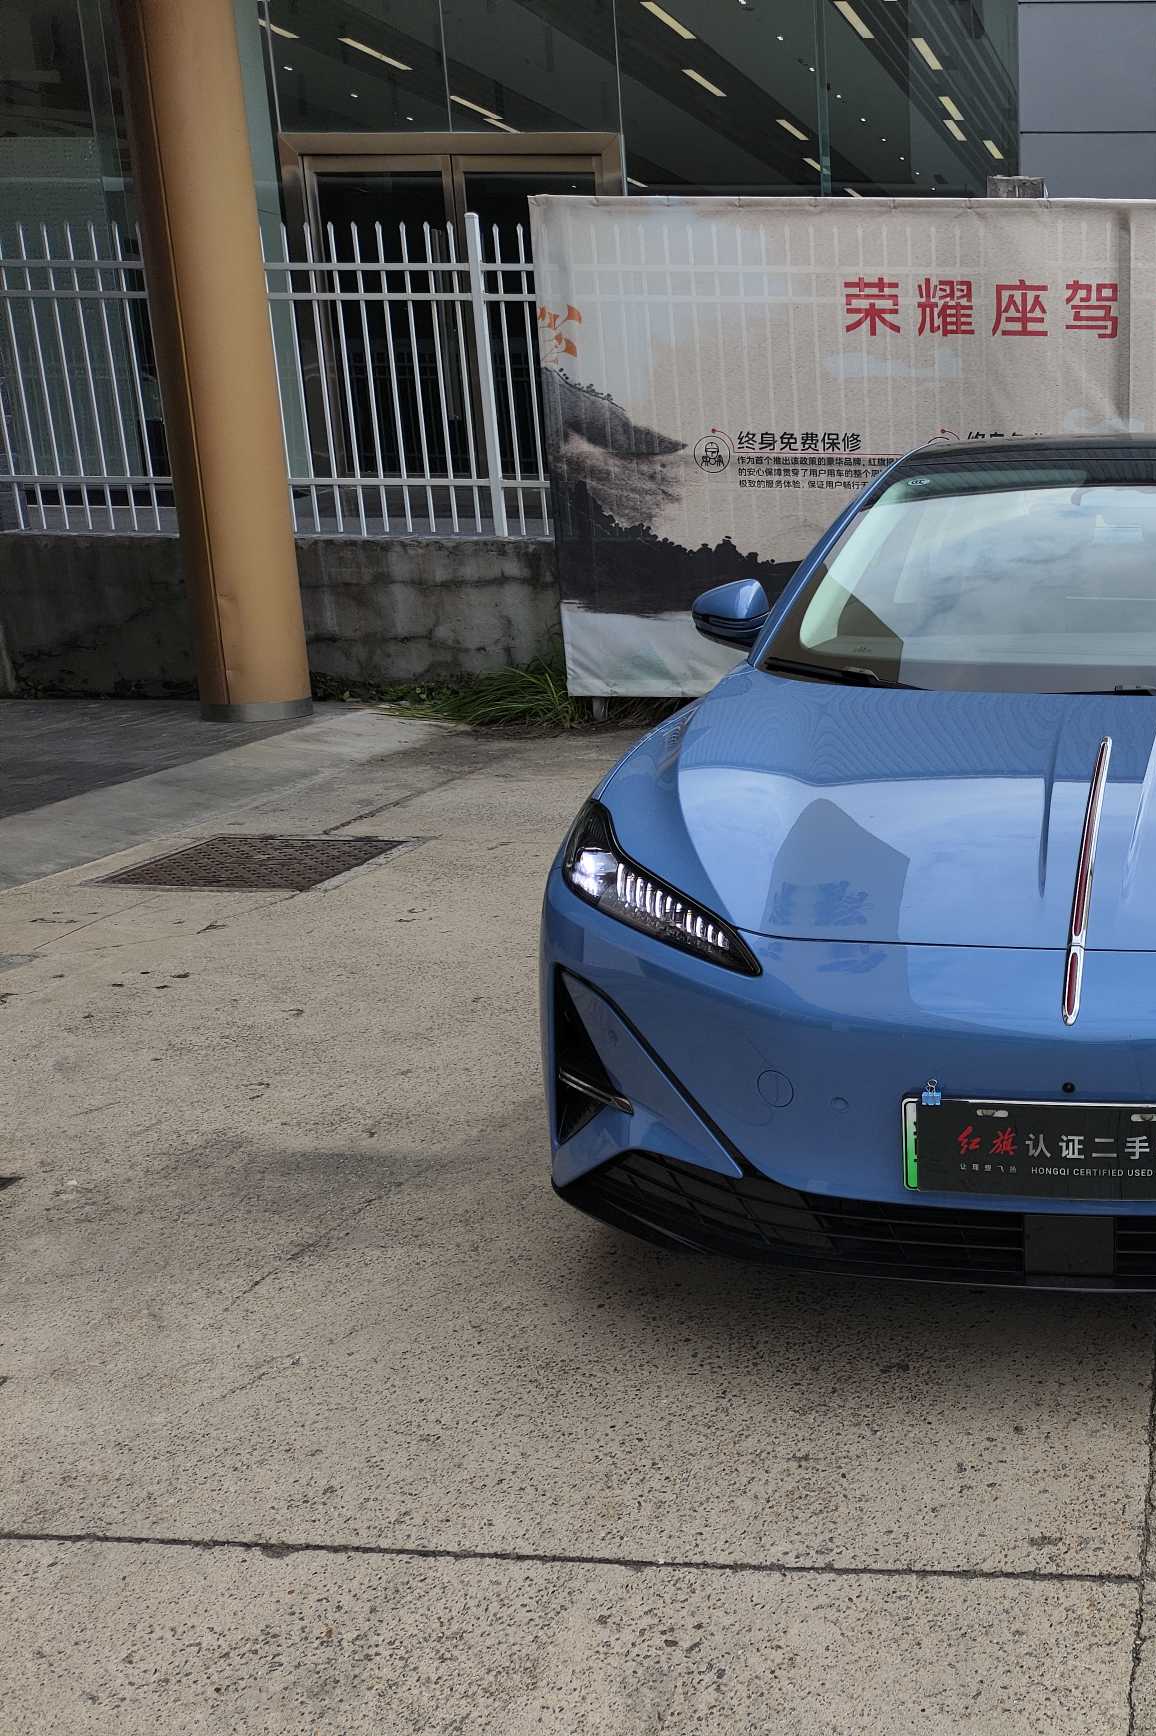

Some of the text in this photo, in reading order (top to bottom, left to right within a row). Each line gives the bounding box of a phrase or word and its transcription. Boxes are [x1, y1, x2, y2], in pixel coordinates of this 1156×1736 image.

[843, 277, 1119, 339] 荣耀座驾
[737, 431, 862, 452] 终身免费保修
[957, 1126, 1018, 1155] 红旗
[1031, 1167, 1070, 1176] HONGQI
[1073, 1168, 1124, 1177] CERTIFIED
[1127, 1169, 1153, 1177] USED
